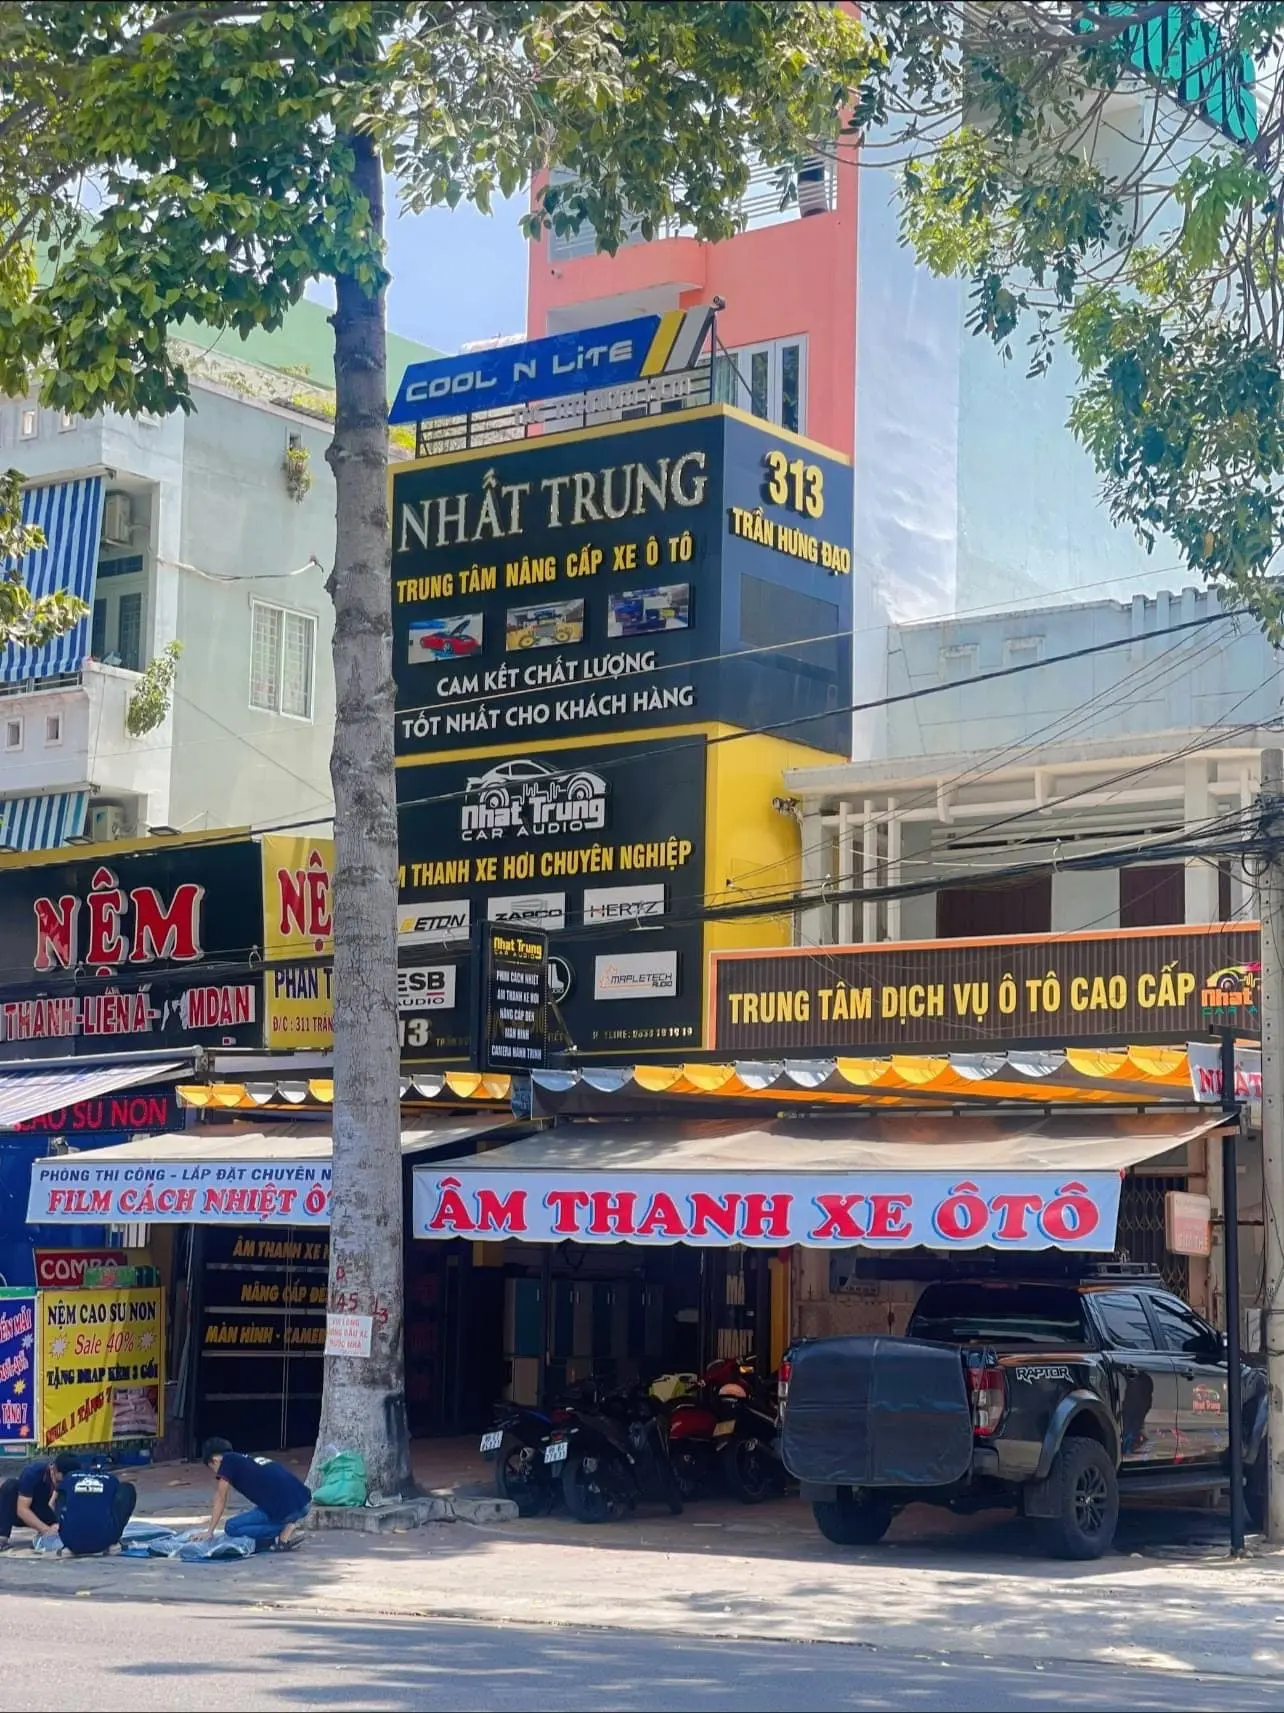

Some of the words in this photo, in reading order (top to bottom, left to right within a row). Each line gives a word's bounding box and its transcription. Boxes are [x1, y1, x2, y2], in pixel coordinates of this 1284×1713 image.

[406, 370, 497, 402] COOL
[513, 359, 537, 382] N
[397, 468, 531, 553] NHẤT
[541, 451, 708, 529] TRUNG
[767, 450, 824, 519] 313
[732, 506, 774, 547] TRẦN
[777, 523, 818, 564] HƯNG
[821, 540, 851, 577] ĐẠO
[396, 574, 454, 605] TRUNG
[459, 563, 497, 594] TÂM
[505, 555, 557, 588] NÂNG
[566, 543, 603, 579] CẤP
[612, 543, 637, 571] XE
[645, 535, 659, 566] Ô
[668, 530, 693, 562] TÔ
[436, 674, 479, 698] CAM
[483, 661, 520, 691] KẾT
[523, 654, 580, 686] CHẤT
[583, 649, 656, 681] LƯỢNG
[402, 709, 442, 740] TỐT
[445, 703, 501, 734] NHẤT
[505, 704, 550, 728] CHO
[555, 692, 627, 722] KHÁCH
[632, 685, 694, 712] HÀNG
[461, 828, 504, 841] CAR
[516, 819, 584, 837] AUDIO
[528, 796, 606, 830] Trung
[412, 860, 470, 887] THANH
[475, 857, 498, 882] XE
[503, 852, 535, 881] HƠI
[541, 843, 614, 877] CHUYÊN
[619, 835, 693, 872] NGHIỆP
[33, 866, 204, 978] NỆM
[277, 850, 334, 953] NỆ
[415, 913, 467, 931] ETON
[590, 901, 659, 918] HERTZ
[397, 971, 446, 991] ESB
[728, 989, 810, 1026] TRUNG
[818, 980, 873, 1022] TÂM
[881, 984, 944, 1025] DỊCH
[953, 982, 989, 1024] VỤ
[998, 973, 1015, 1015] Ô
[1025, 970, 1062, 1013] TÔ
[1070, 975, 1127, 1012] CAO
[1137, 960, 1196, 1009] CẤP
[295, 1015, 311, 1032] 311
[72, 1099, 104, 1130] SU
[111, 1097, 167, 1128] NON
[95, 1169, 119, 1182] THI
[124, 1167, 166, 1182] CÔNG
[216, 1166, 248, 1184] ĐẶT
[250, 1165, 315, 1182] CHUYÊN
[46, 1187, 113, 1215] FILM
[118, 1182, 197, 1215] CÁCH
[200, 1181, 298, 1222] NHIỆT
[427, 1176, 527, 1233] ÂM
[543, 1190, 795, 1239] THANH
[808, 1193, 913, 1240] XE
[257, 1240, 303, 1260] THANH
[47, 1299, 77, 1330] NỆM
[79, 1302, 107, 1324] CAO
[129, 1301, 157, 1322] NON
[74, 1333, 102, 1355] Sale
[106, 1331, 135, 1353] 40%
[1016, 1366, 1075, 1385] RAPTOR
